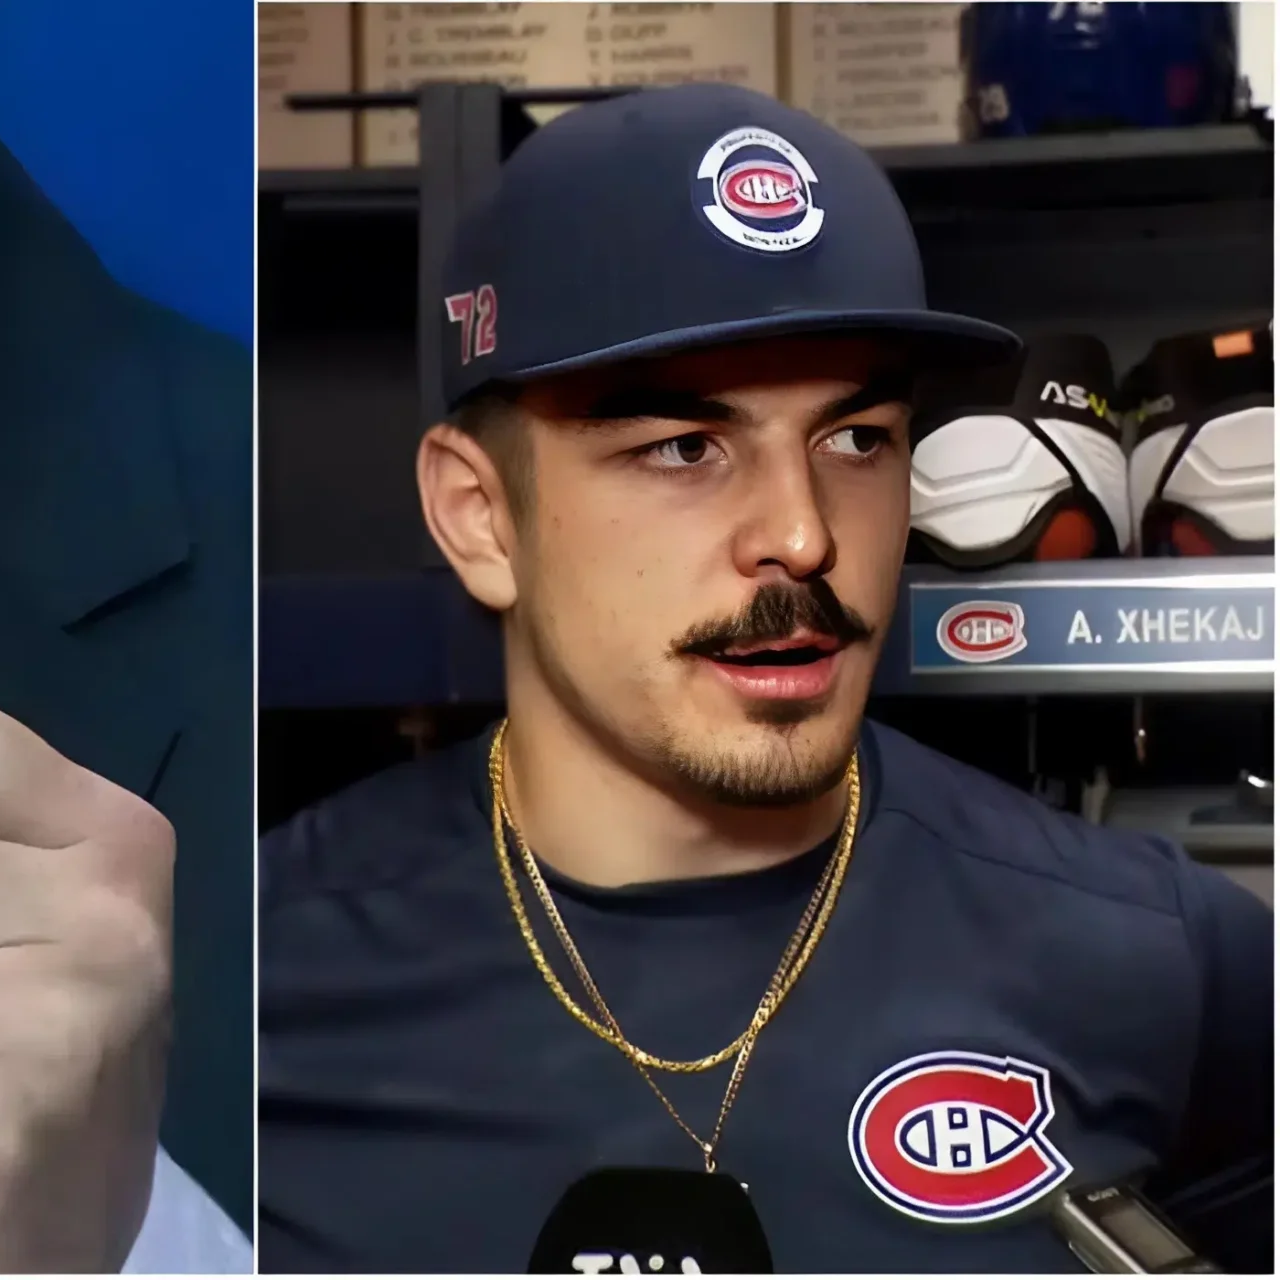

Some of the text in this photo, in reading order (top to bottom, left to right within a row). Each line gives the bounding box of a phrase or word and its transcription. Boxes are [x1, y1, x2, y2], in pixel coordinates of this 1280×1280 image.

[444, 283, 498, 366] 72
[1067, 605, 1265, 645] A. XHEKAJ
